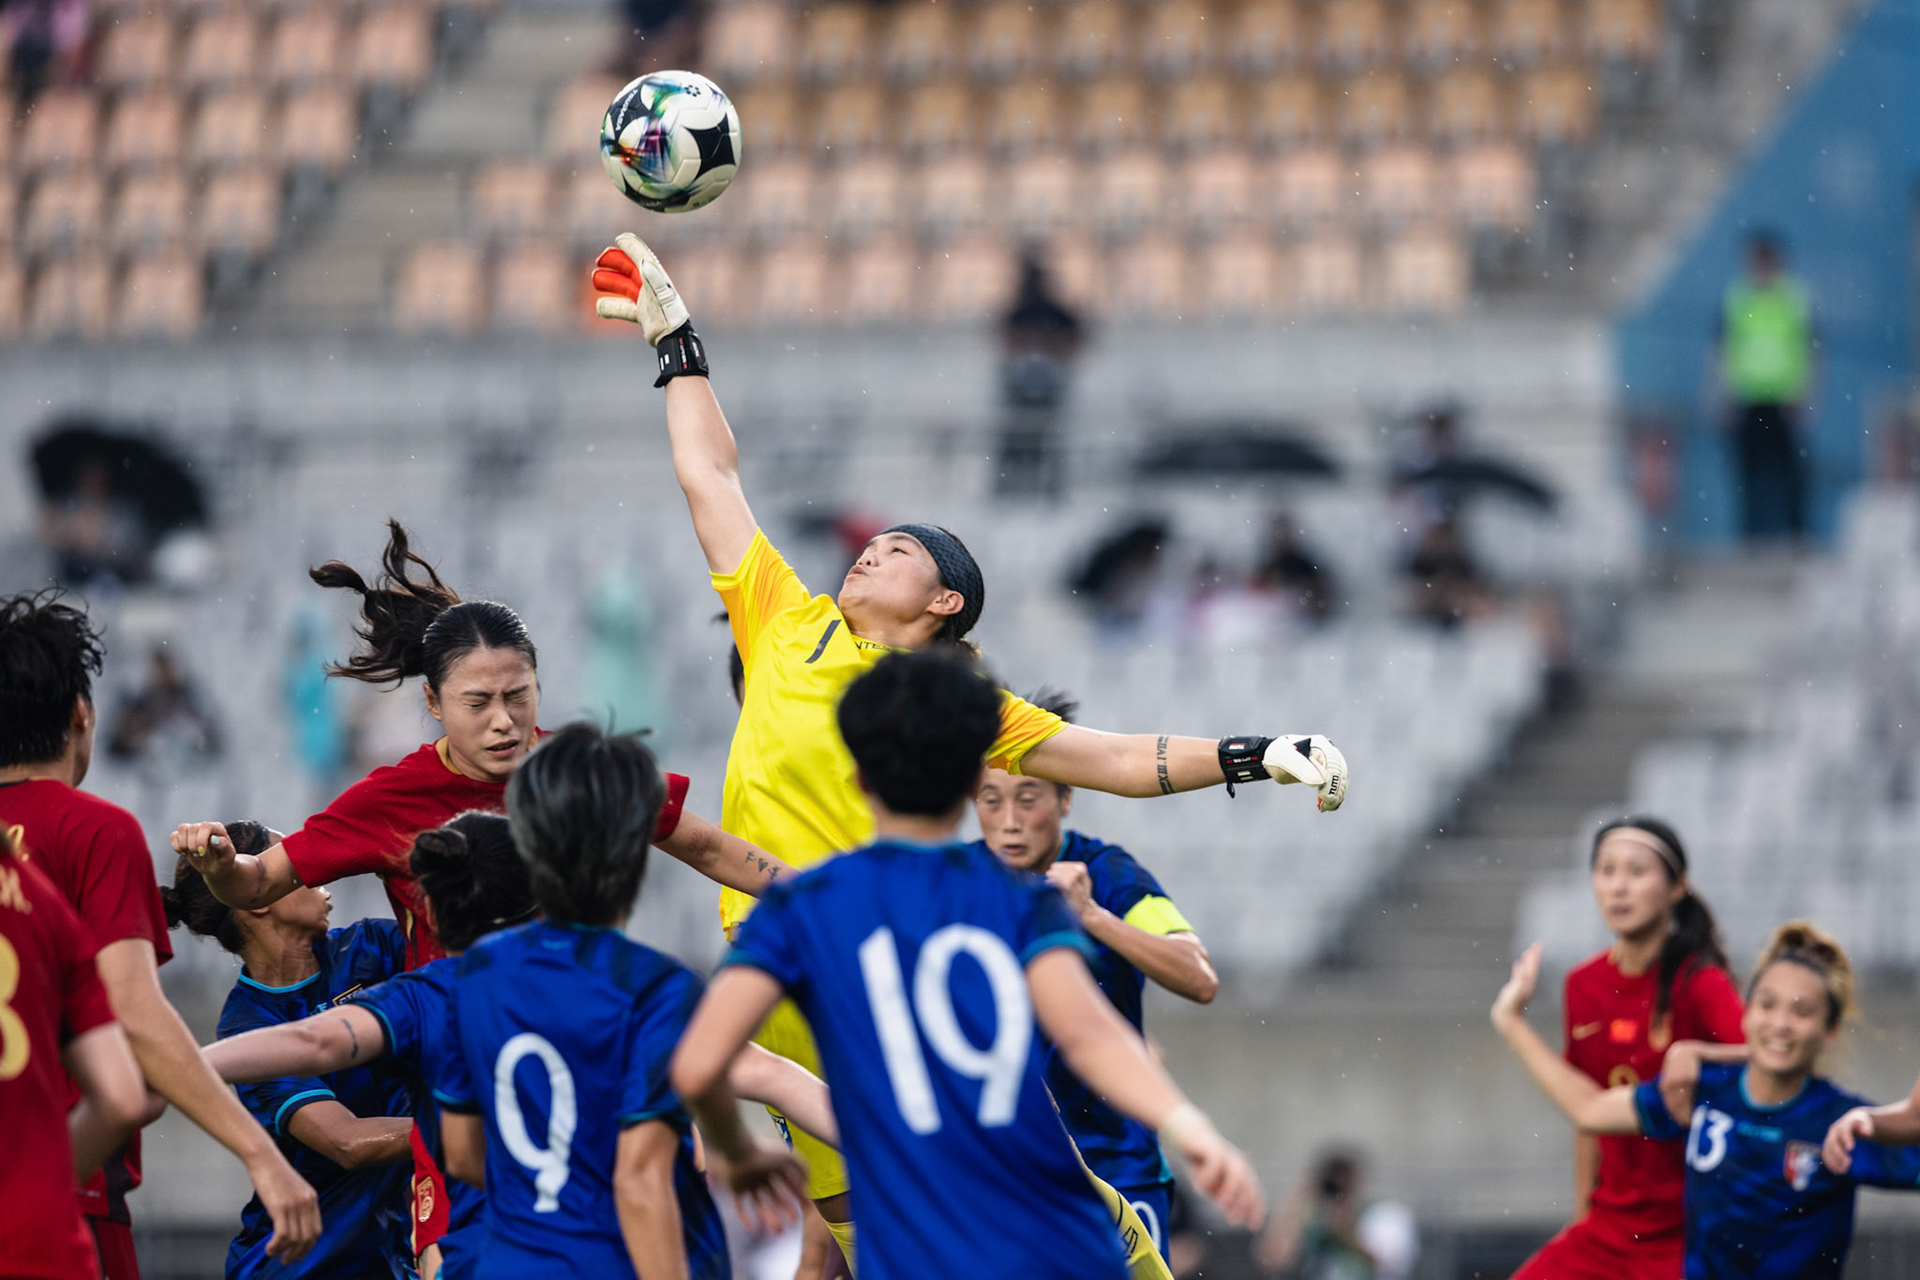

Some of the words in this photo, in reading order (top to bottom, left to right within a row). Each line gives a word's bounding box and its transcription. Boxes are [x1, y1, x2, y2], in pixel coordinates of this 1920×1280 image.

[615, 88, 639, 131] TSUBASA
[858, 923, 1034, 1136] 19
[494, 1032, 578, 1214] 9
[1685, 1104, 1735, 1173] 13
